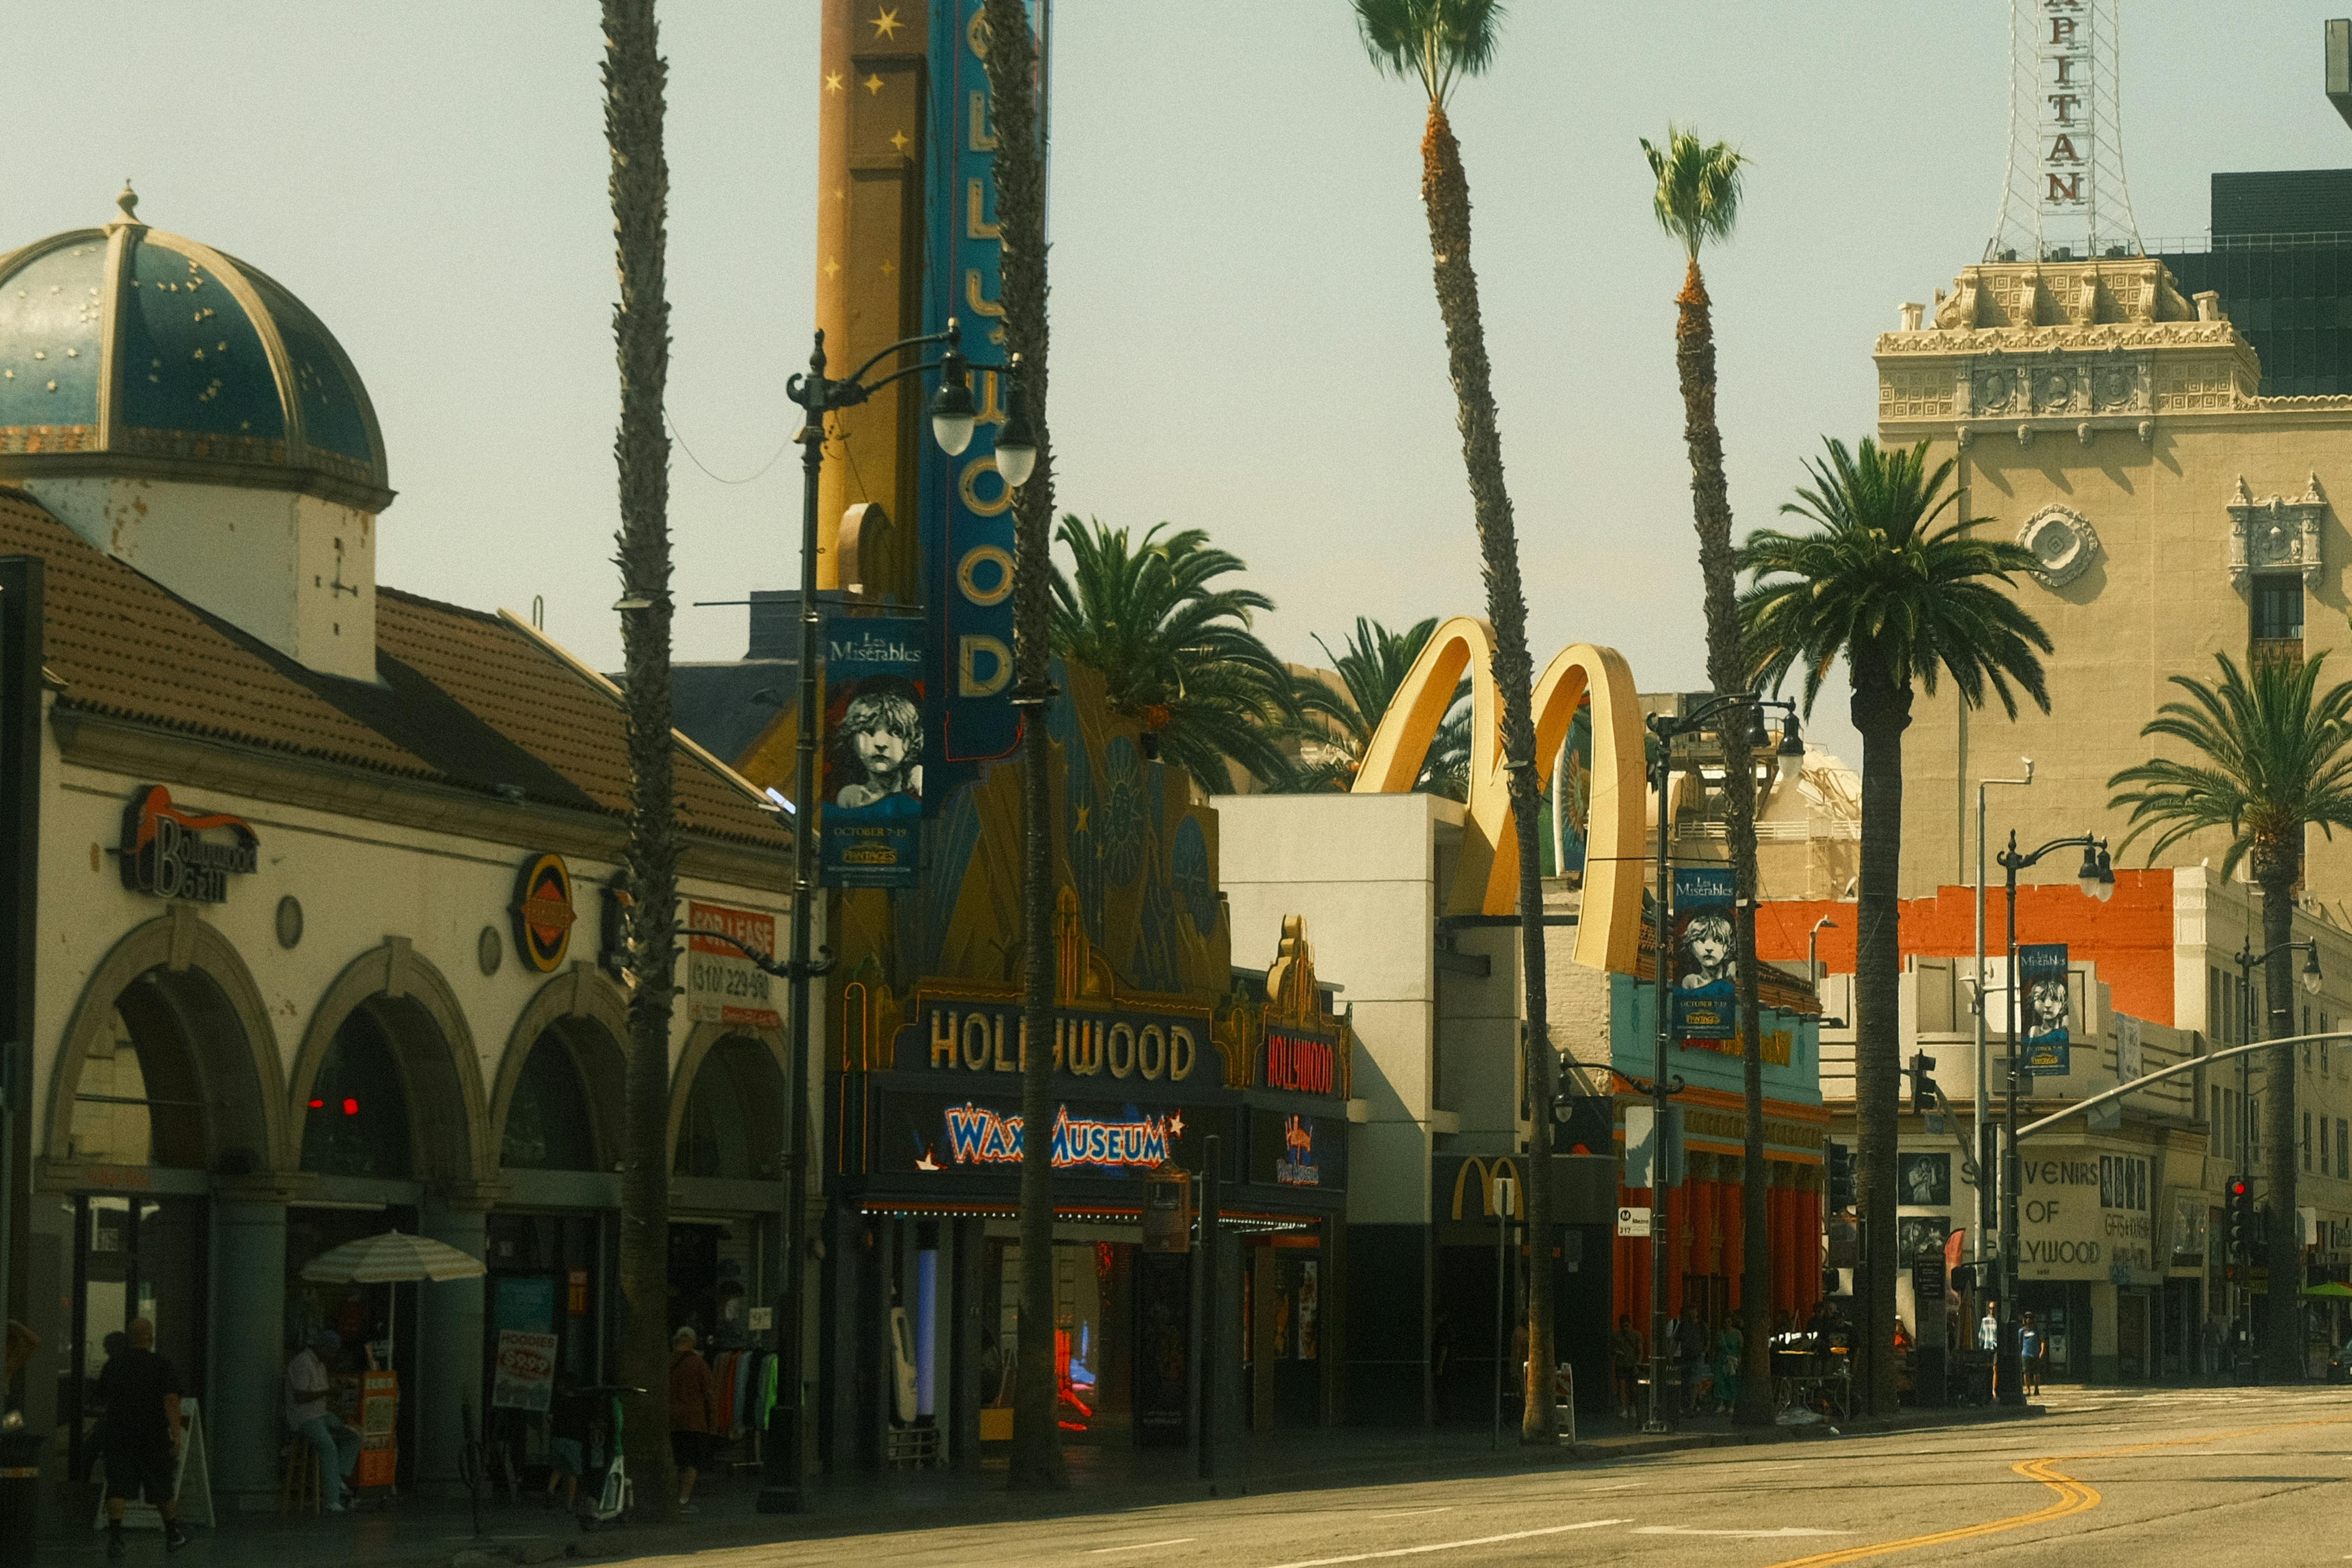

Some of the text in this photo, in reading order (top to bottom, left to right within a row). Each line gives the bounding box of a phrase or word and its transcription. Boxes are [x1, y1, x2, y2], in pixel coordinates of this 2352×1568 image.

[2043, 0, 2080, 201] PITAN
[863, 632, 886, 647] Les
[830, 641, 922, 662] Misérables
[833, 827, 884, 837] OCTOBER
[693, 909, 773, 956] FOR LEASE
[1268, 1034, 1333, 1093] HOLLYWOOD
[1961, 1160, 2098, 1185] SVENIRS
[2025, 1200, 2060, 1223] OF
[502, 1333, 554, 1348] HOODIES
